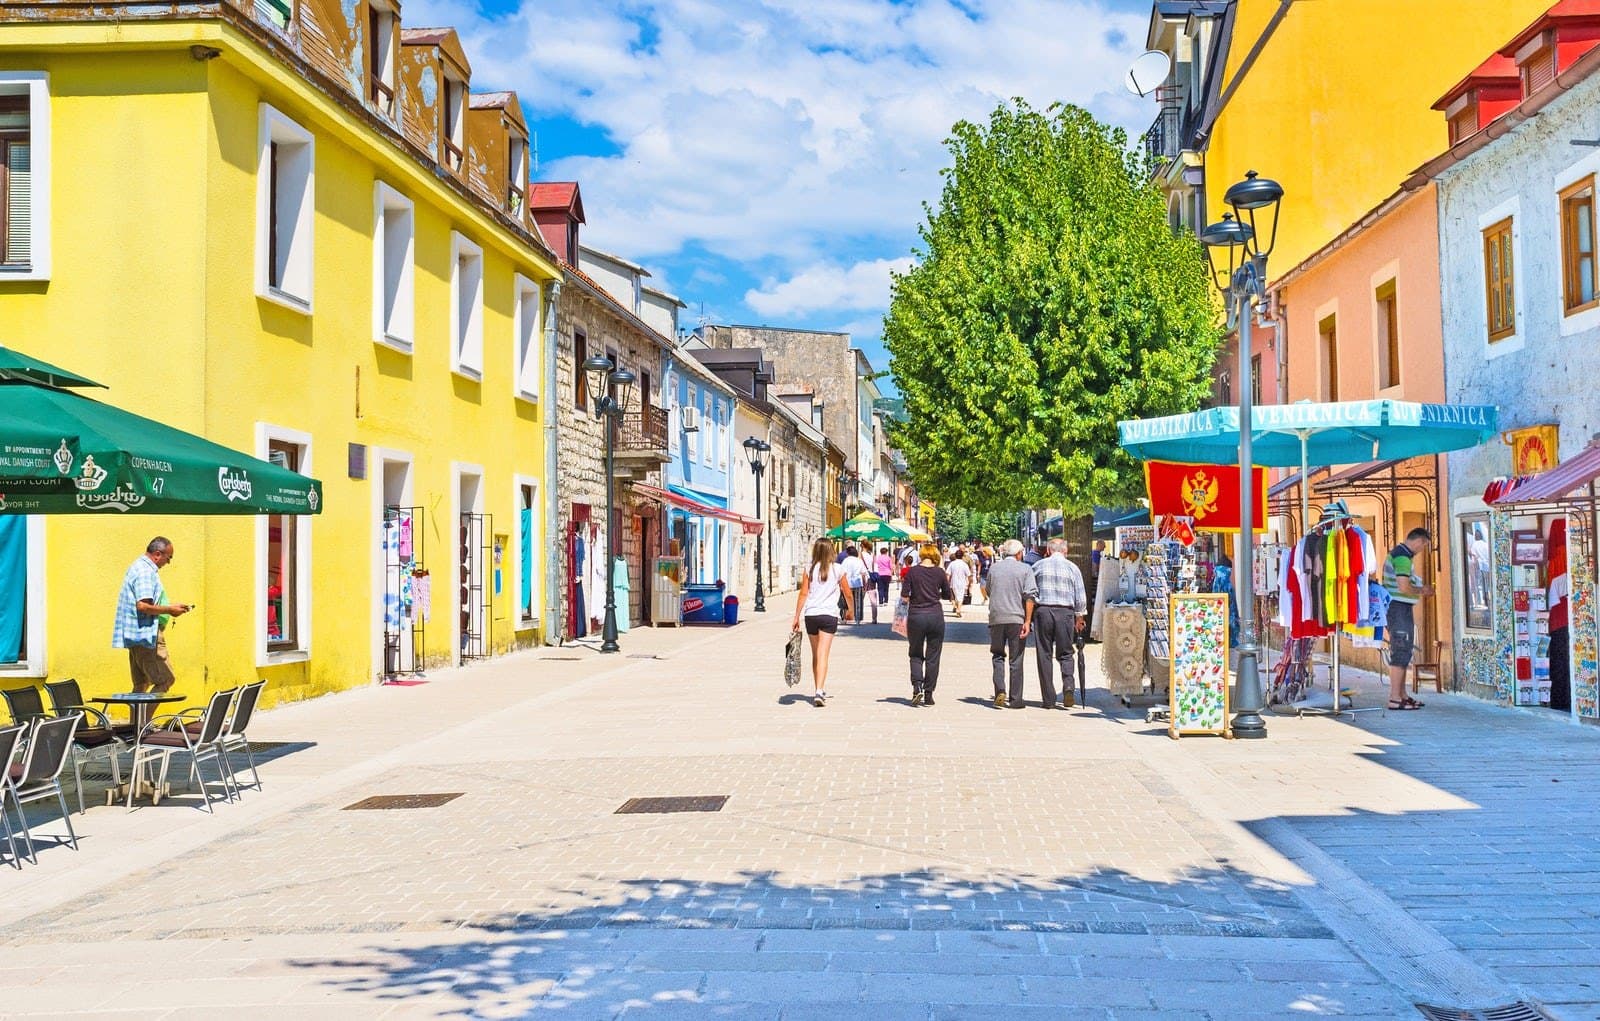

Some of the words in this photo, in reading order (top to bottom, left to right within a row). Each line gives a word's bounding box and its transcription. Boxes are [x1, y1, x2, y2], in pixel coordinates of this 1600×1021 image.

[1229, 402, 1371, 426] SVENIRNICA
[1392, 403, 1486, 425] SUVENIRNICA
[13, 446, 45, 455] APPOINTMENT
[13, 457, 34, 468] DANISH
[35, 458, 51, 468] COURT
[131, 456, 173, 472] COPENHAGEN
[152, 477, 164, 494] 47
[218, 466, 252, 502] Carlsberg
